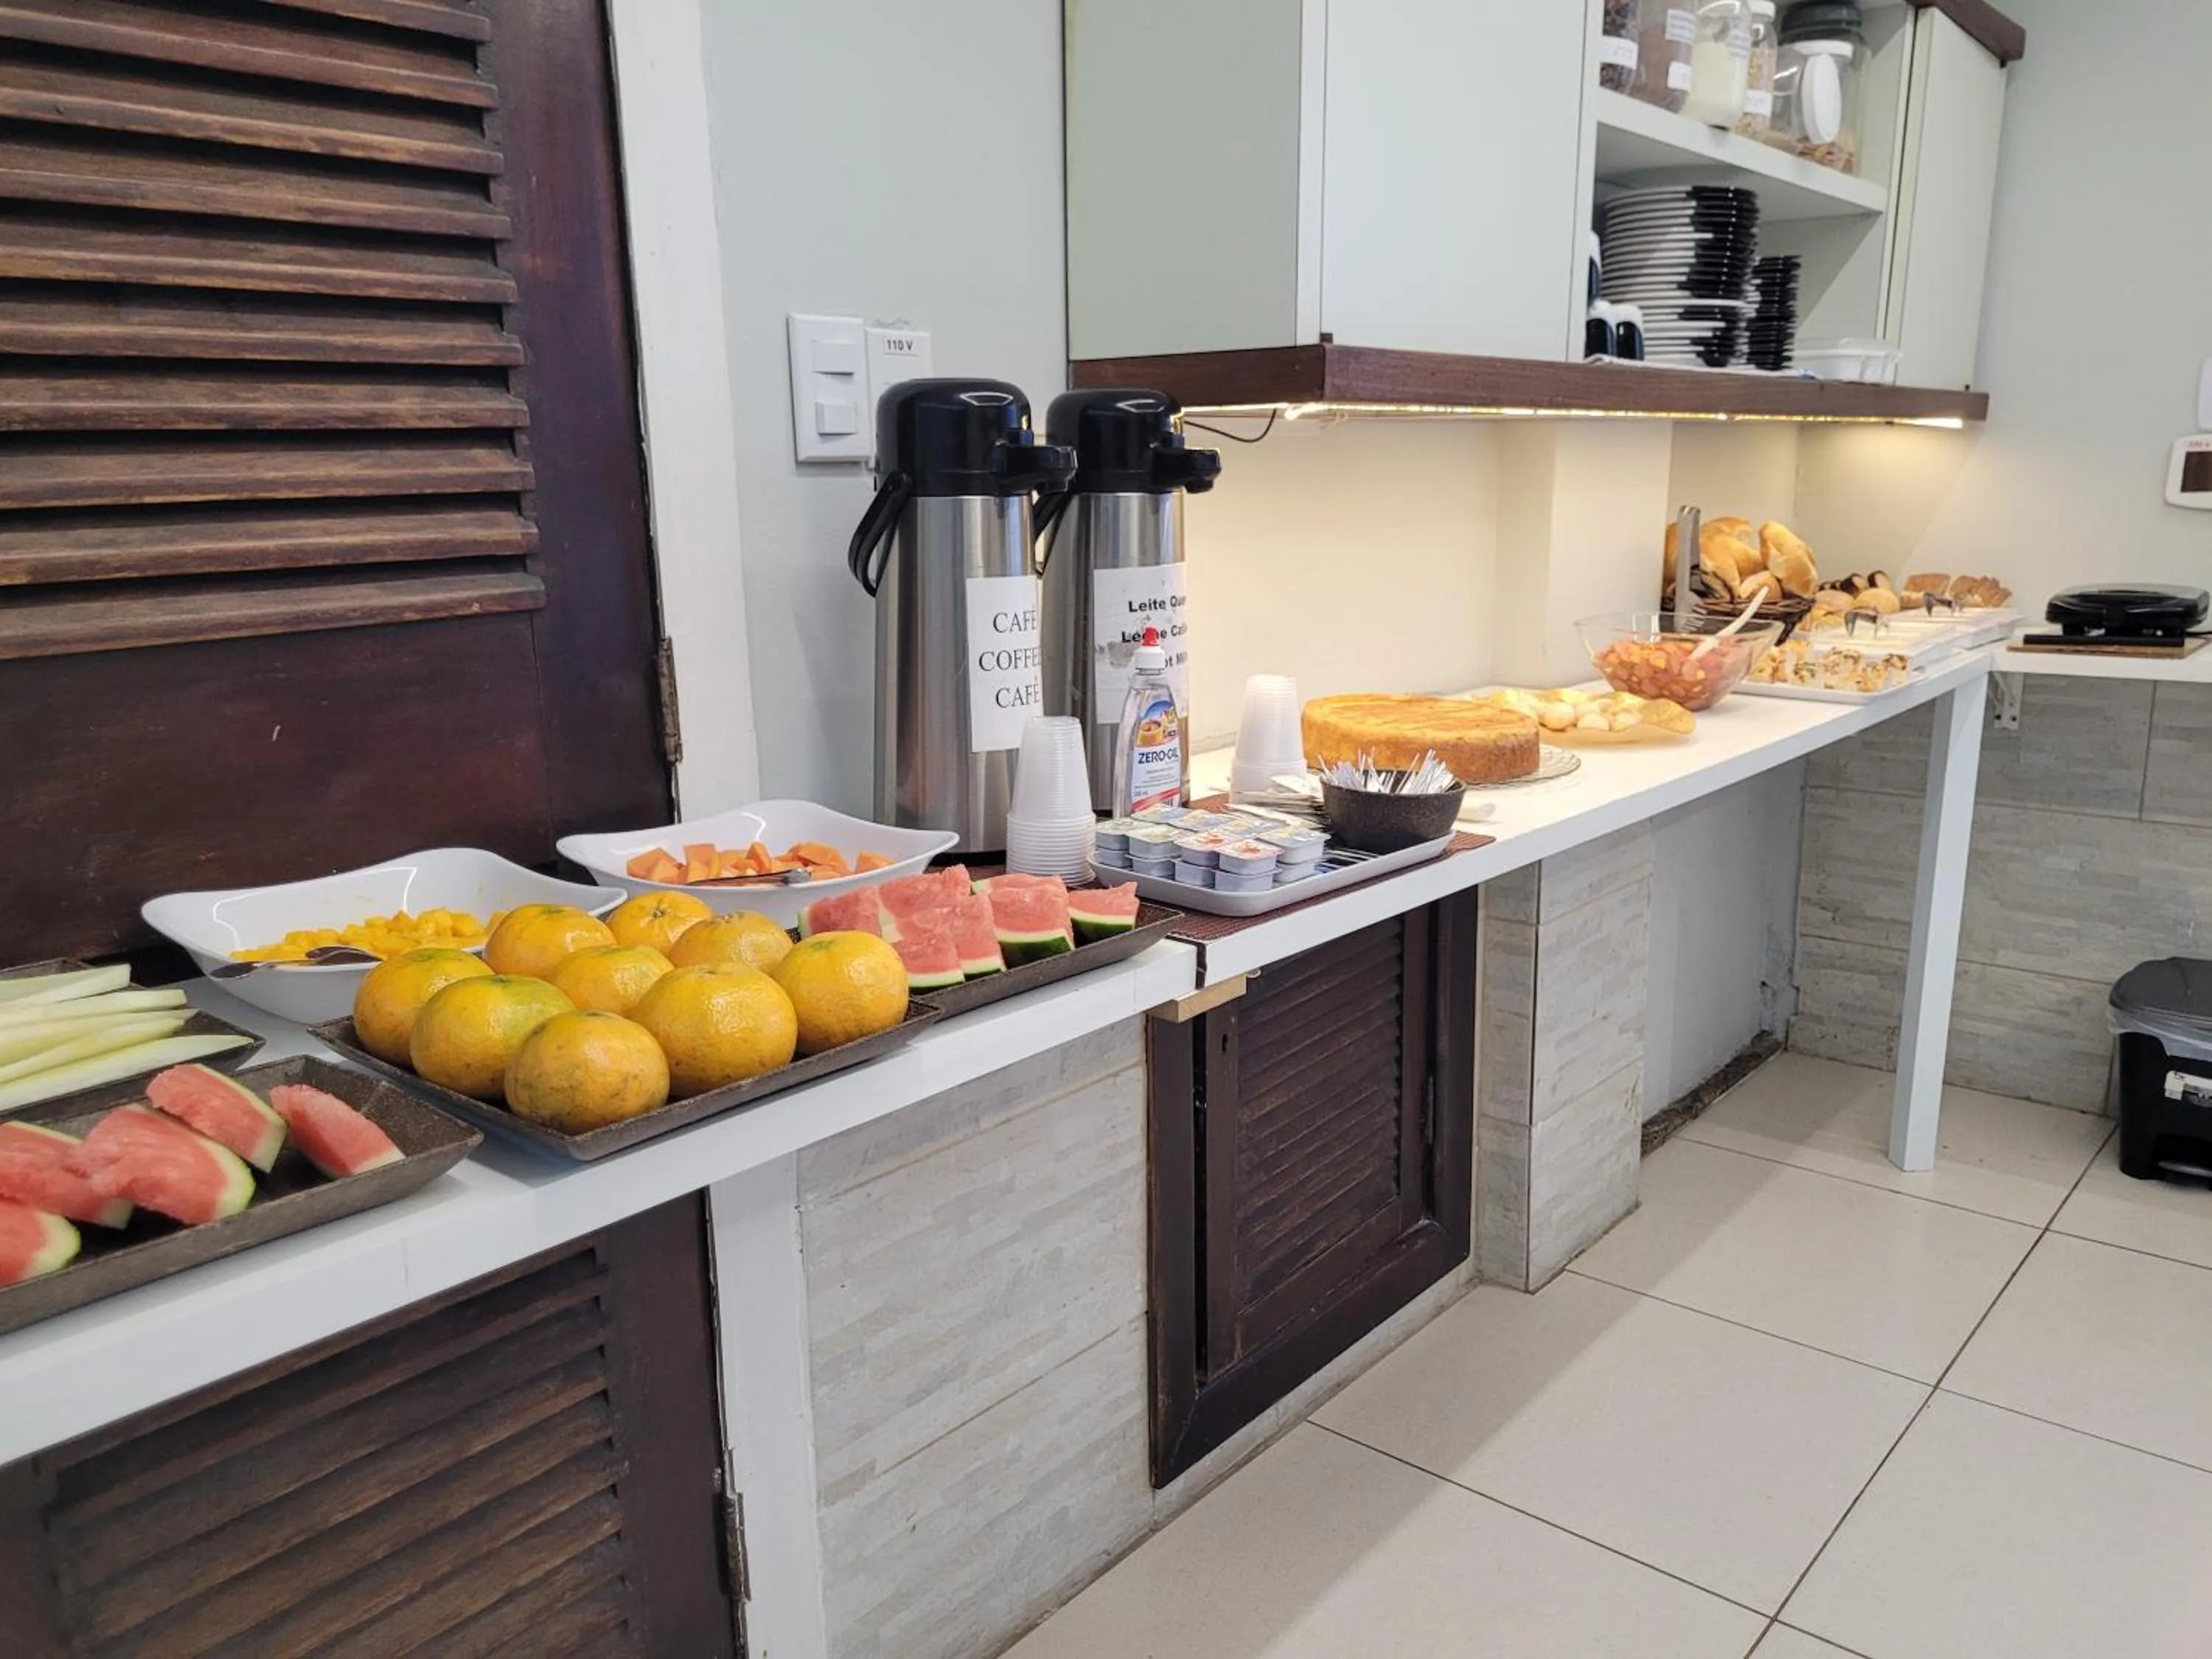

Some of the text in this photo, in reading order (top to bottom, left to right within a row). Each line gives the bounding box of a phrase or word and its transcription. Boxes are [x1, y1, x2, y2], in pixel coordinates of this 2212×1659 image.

[887, 340, 914, 351] 110 V
[1128, 598, 1166, 613] Leite
[1121, 627, 1167, 643] Lee
[995, 676, 1041, 709] CAFÉ
